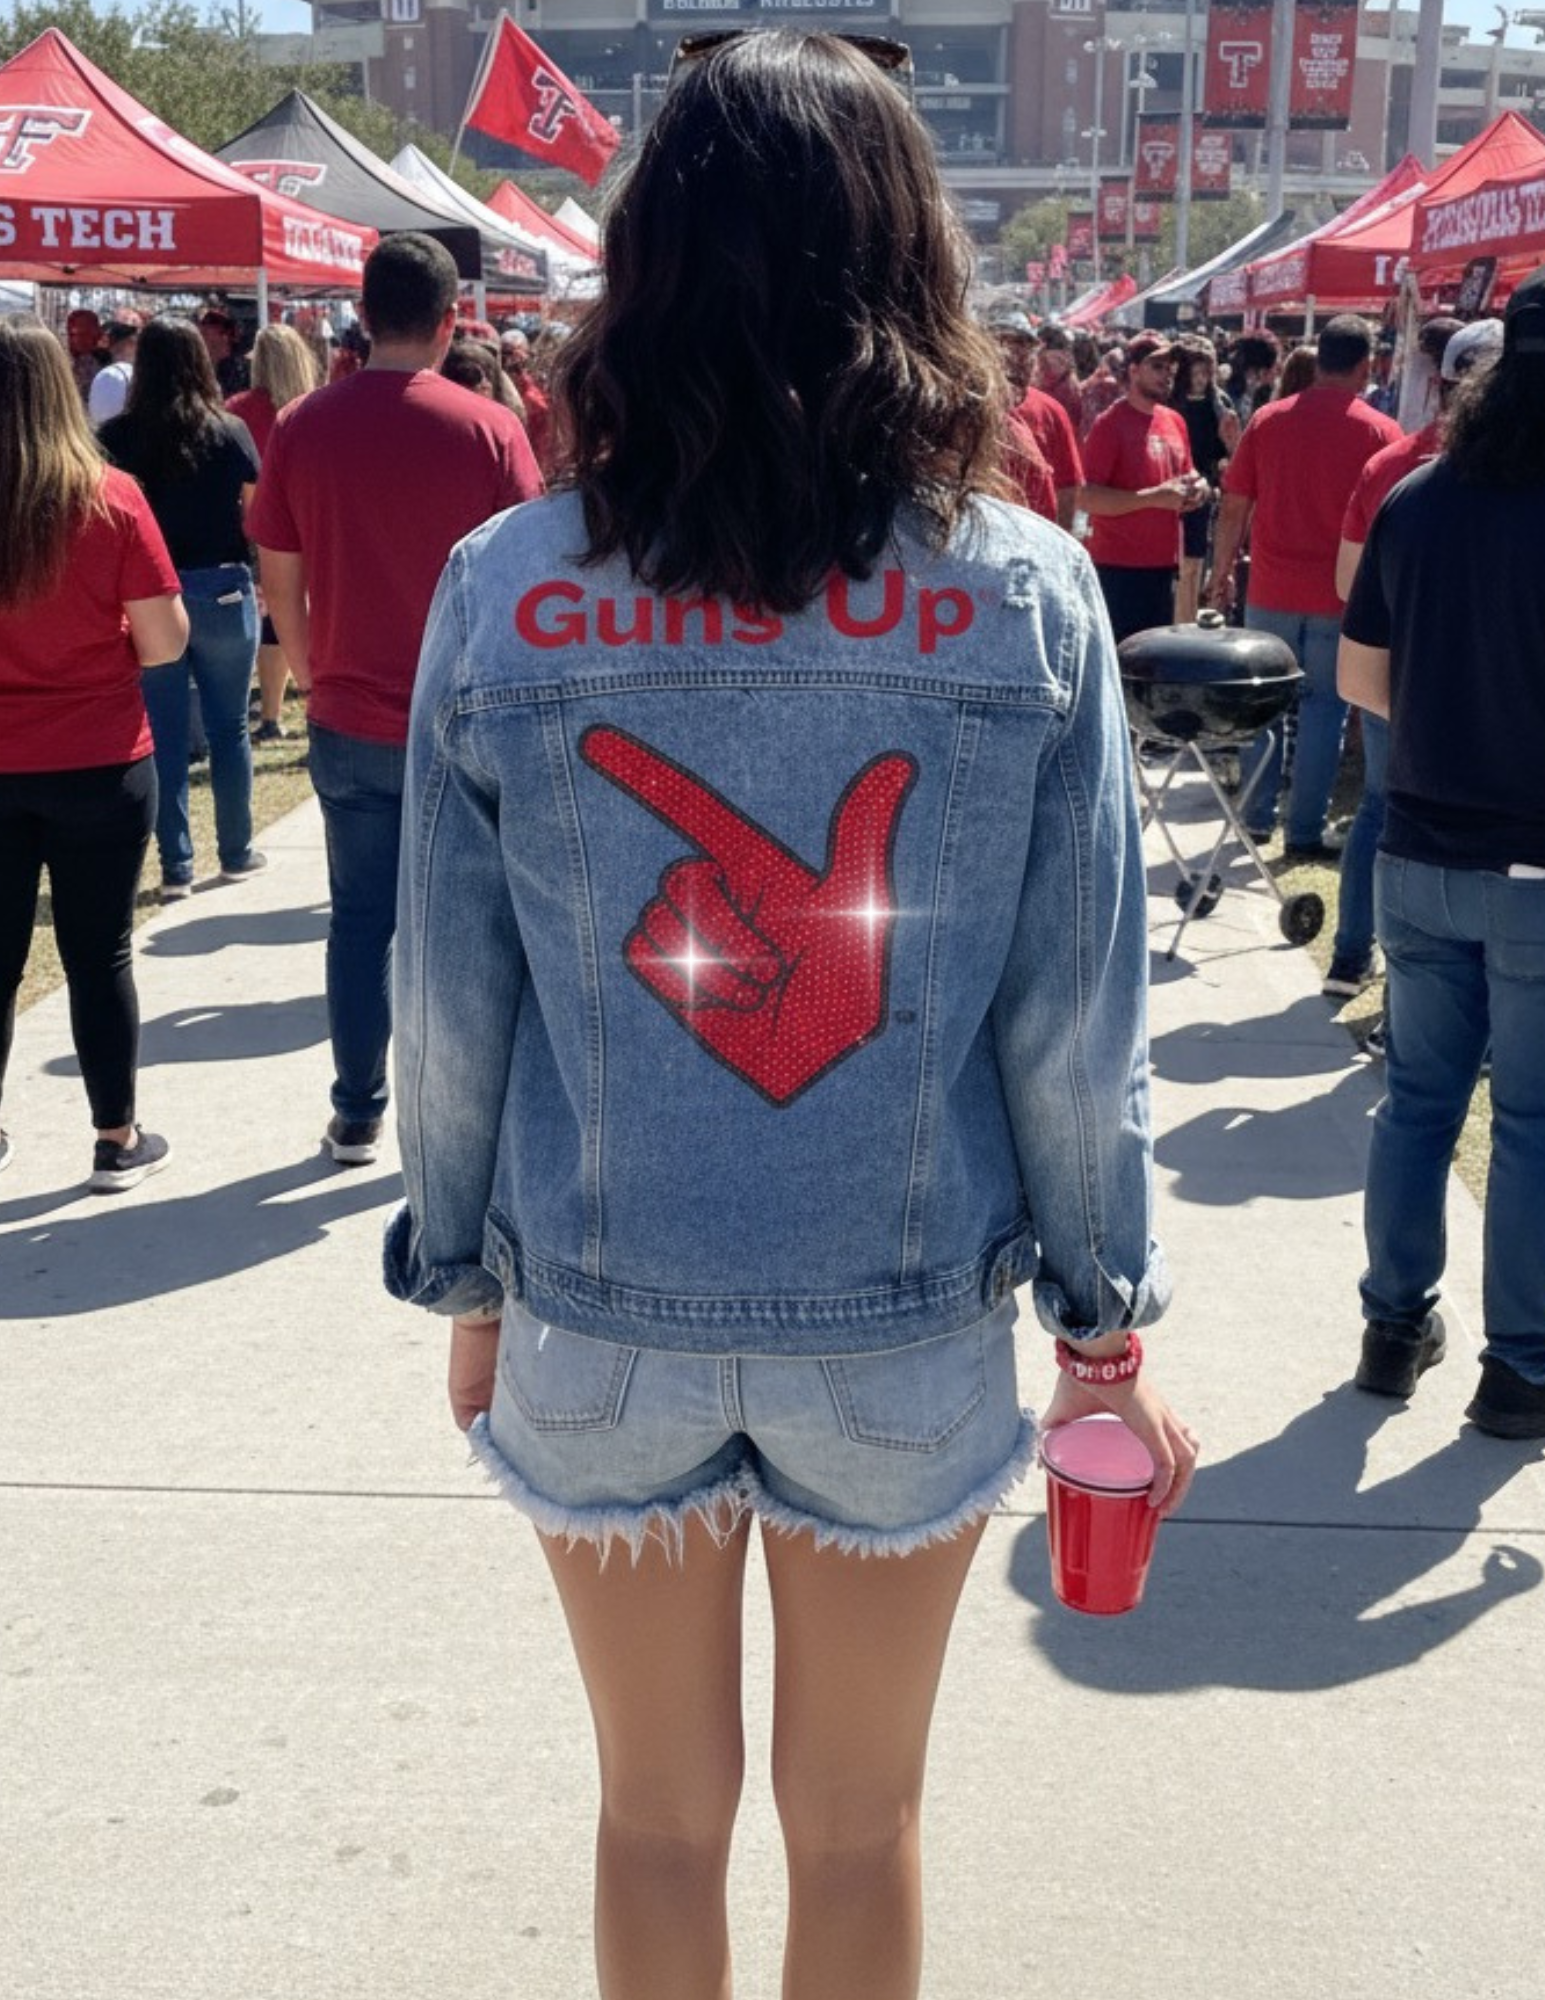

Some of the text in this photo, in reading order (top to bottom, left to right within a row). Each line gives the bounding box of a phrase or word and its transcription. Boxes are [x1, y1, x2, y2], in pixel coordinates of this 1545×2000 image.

[31, 207, 176, 249] TECH
[514, 566, 975, 654] Guns Up
